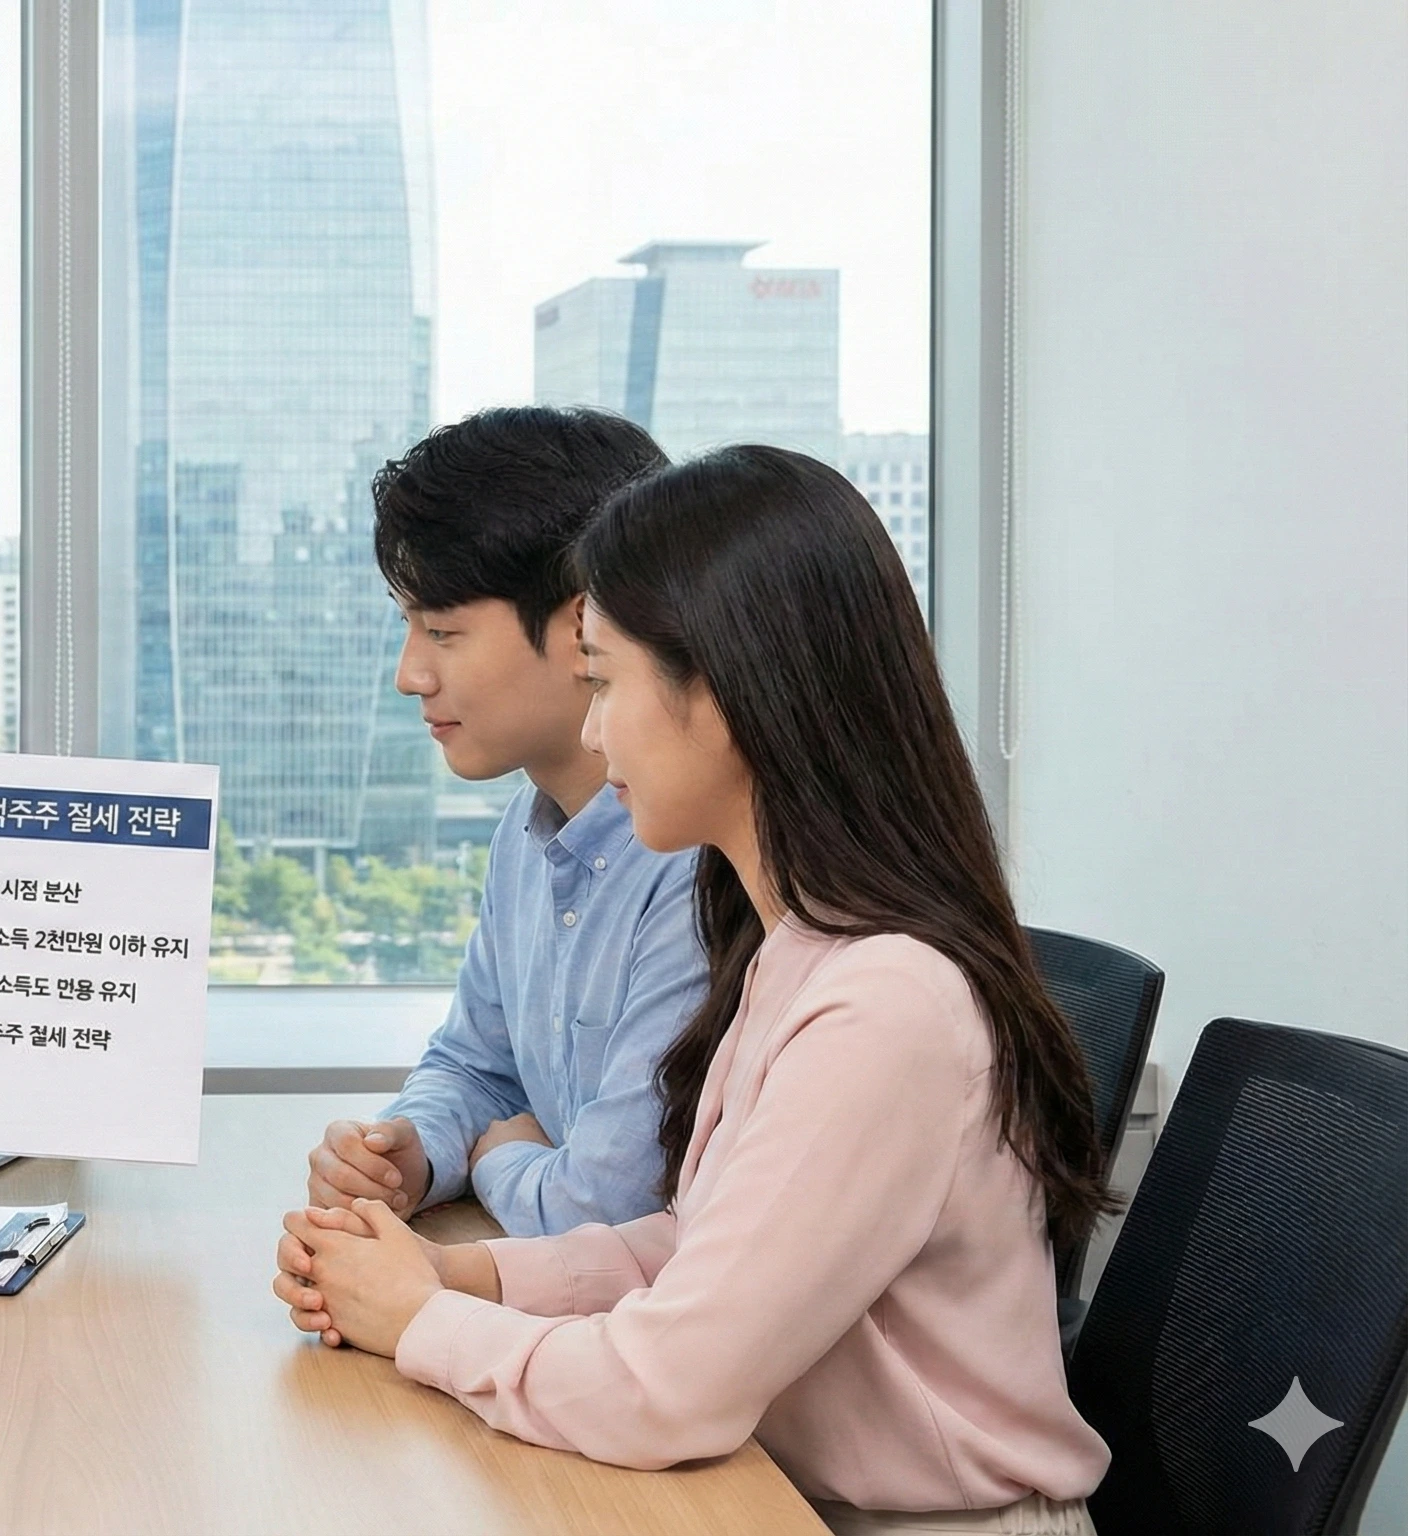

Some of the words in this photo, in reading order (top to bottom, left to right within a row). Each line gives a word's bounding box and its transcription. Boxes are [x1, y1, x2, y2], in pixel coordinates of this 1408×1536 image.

[67, 802, 119, 835] 절세
[127, 806, 182, 838] 전략
[0, 878, 38, 902] 시점
[42, 881, 83, 904] 분산
[34, 929, 103, 955] 2천만원
[108, 934, 147, 958] 이하
[150, 936, 189, 960] 유지
[98, 980, 137, 1004] 유지
[72, 1027, 112, 1052] 전략
